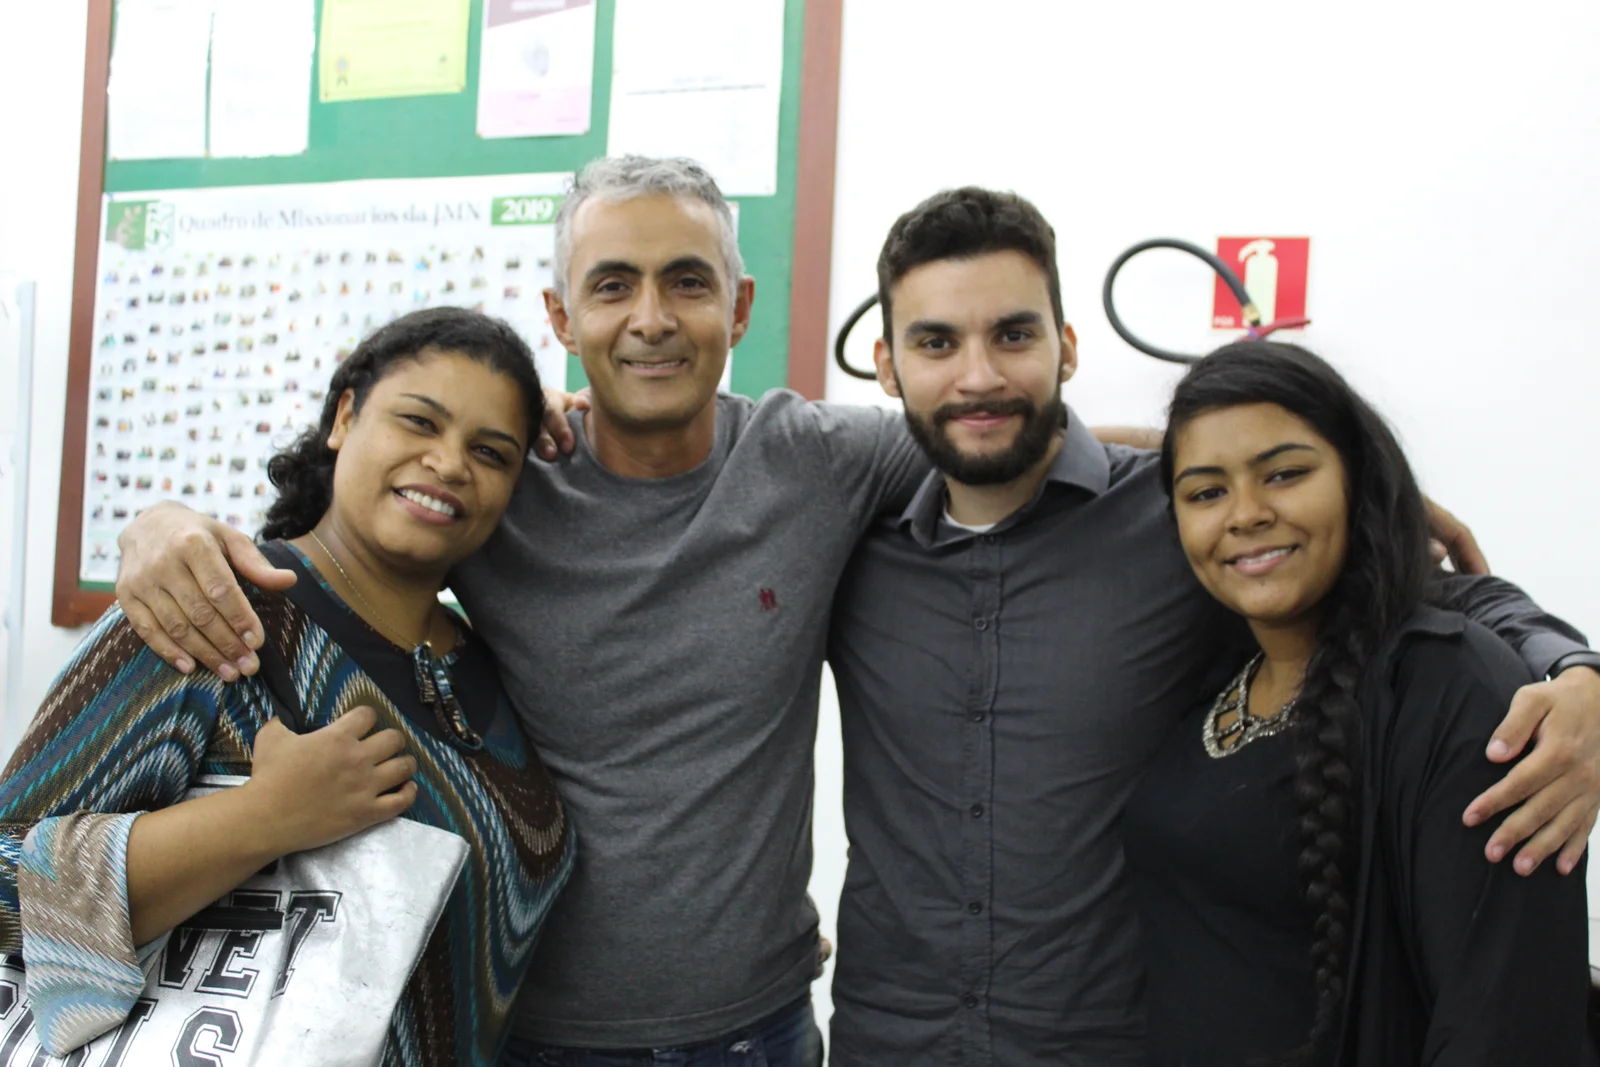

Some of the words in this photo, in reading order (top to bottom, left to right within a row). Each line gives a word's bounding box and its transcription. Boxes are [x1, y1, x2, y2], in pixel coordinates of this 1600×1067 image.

[178, 211, 247, 233] Quadro
[251, 210, 273, 228] de
[402, 201, 427, 223] da
[500, 198, 554, 222] 2019
